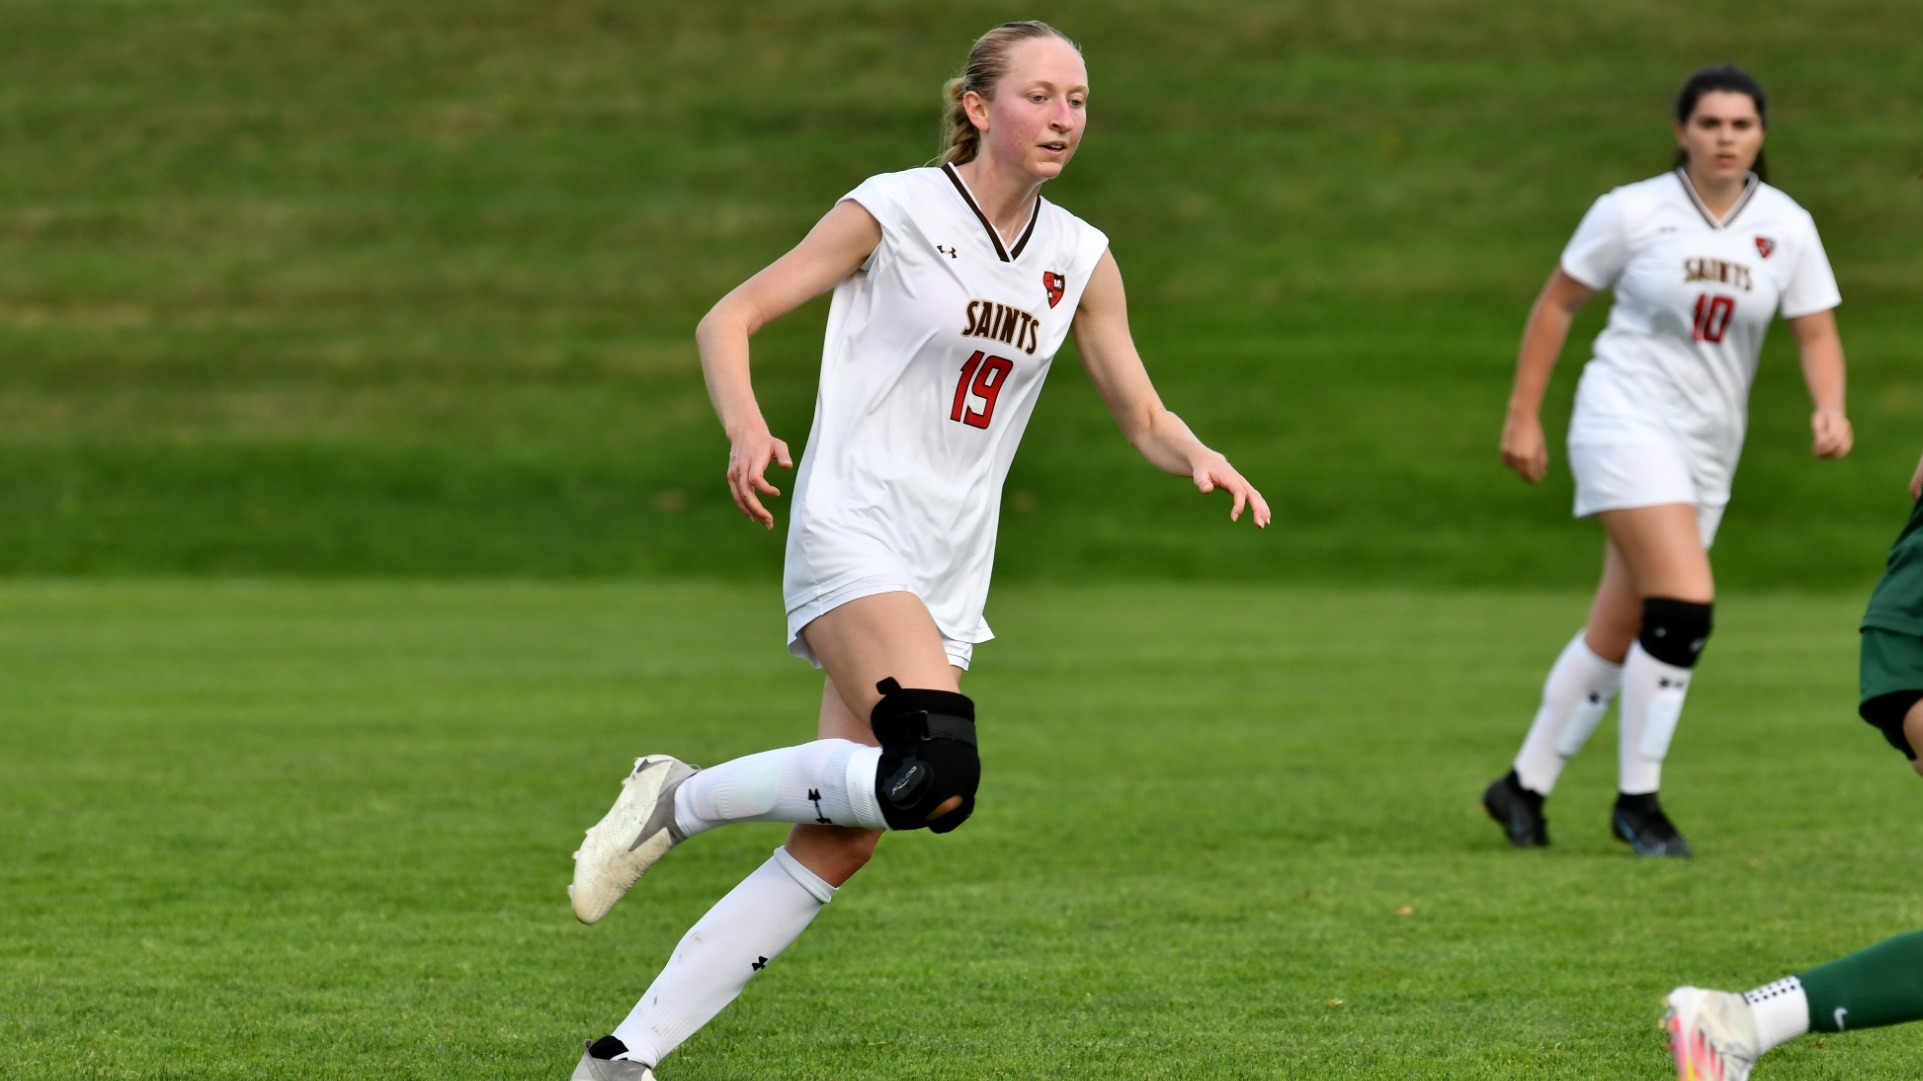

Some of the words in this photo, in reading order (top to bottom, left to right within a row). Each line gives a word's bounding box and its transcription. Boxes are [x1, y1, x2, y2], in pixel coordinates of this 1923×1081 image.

[1684, 257, 1752, 291] SAINTS
[961, 299, 1040, 355] SAINTS
[1693, 294, 1735, 342] 10
[950, 350, 1014, 430] 19
